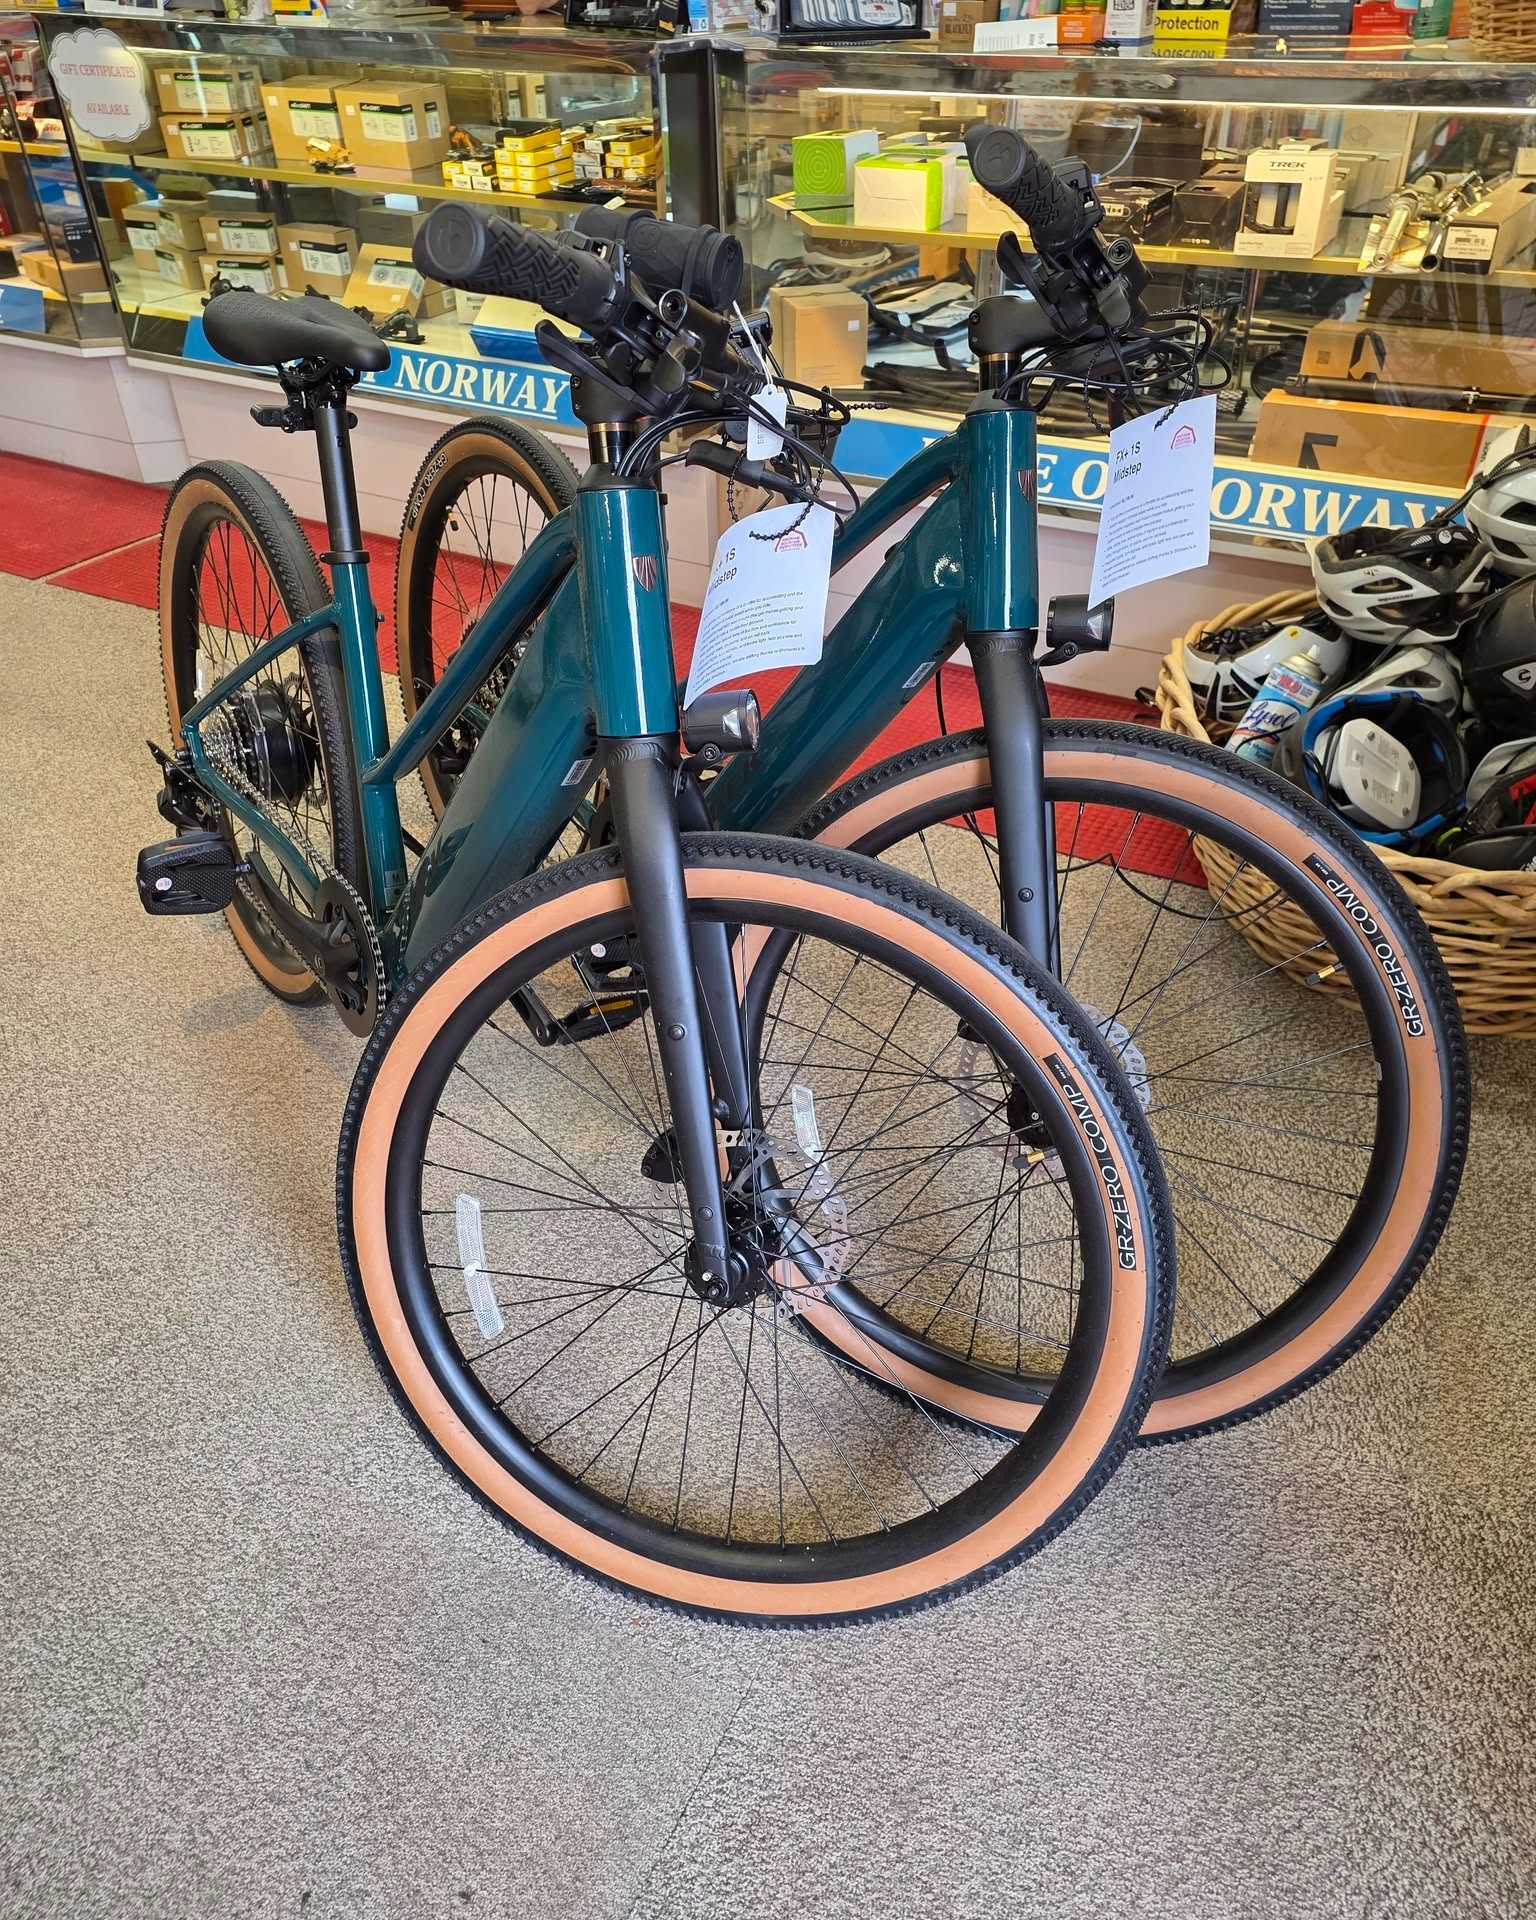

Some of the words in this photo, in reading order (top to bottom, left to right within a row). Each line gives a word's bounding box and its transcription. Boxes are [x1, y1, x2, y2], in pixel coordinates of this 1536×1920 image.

[1155, 16, 1219, 31] Protection
[60, 64, 78, 75] GIFT
[80, 64, 136, 78] CERTIFICATES
[86, 102, 131, 116] AVAILABLE
[394, 355, 570, 414] NORWAY
[1116, 448, 1129, 465] FX+
[1131, 441, 1141, 456] 1S
[1113, 462, 1142, 484] Midstep
[411, 487, 426, 518] COMP
[725, 547, 736, 564] 1S
[1243, 700, 1298, 728] Lysol
[1326, 879, 1378, 935] COMP
[1375, 943, 1424, 1036] GR-ZERO
[1062, 1084, 1107, 1153] COMP
[1101, 1165, 1136, 1270] GR-ZERO
